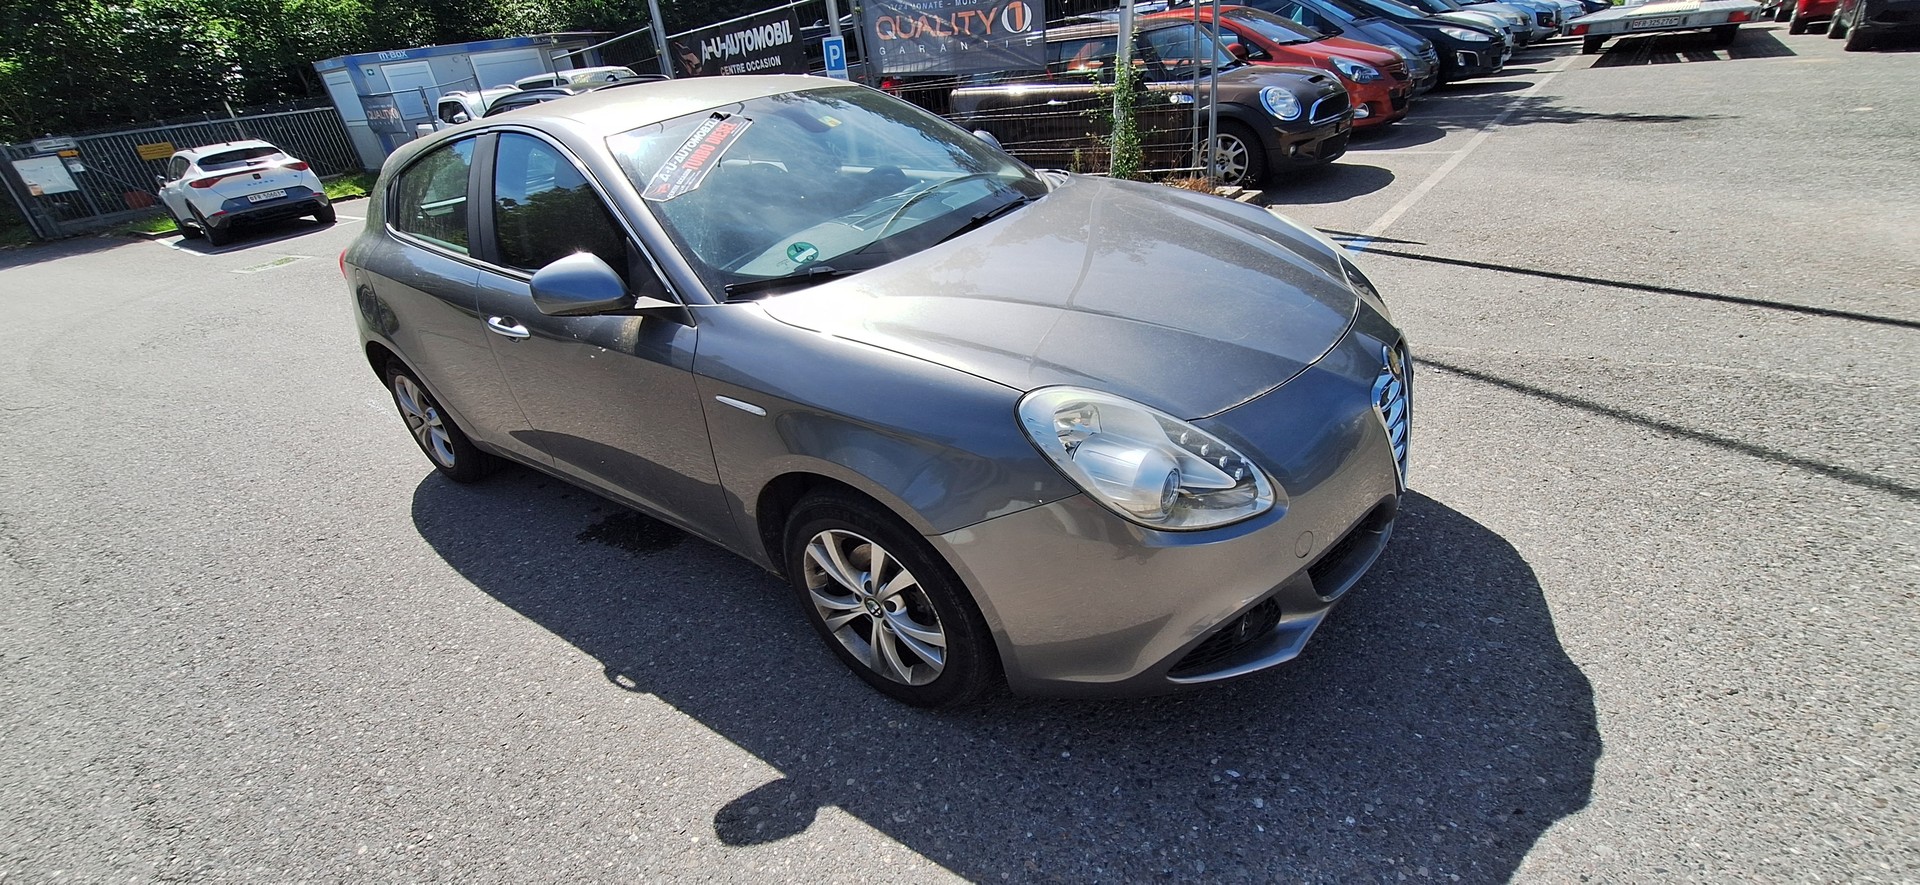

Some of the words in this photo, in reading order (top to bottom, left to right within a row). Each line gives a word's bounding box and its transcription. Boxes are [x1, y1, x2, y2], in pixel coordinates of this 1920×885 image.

[875, 7, 998, 41] QUALITY
[829, 45, 840, 67] P
[879, 38, 1033, 56] GARANTIE
[720, 62, 746, 76] CENTRE
[746, 55, 781, 71] OCCASION
[682, 144, 716, 170] TURBO
[705, 122, 737, 145] DIESEL
